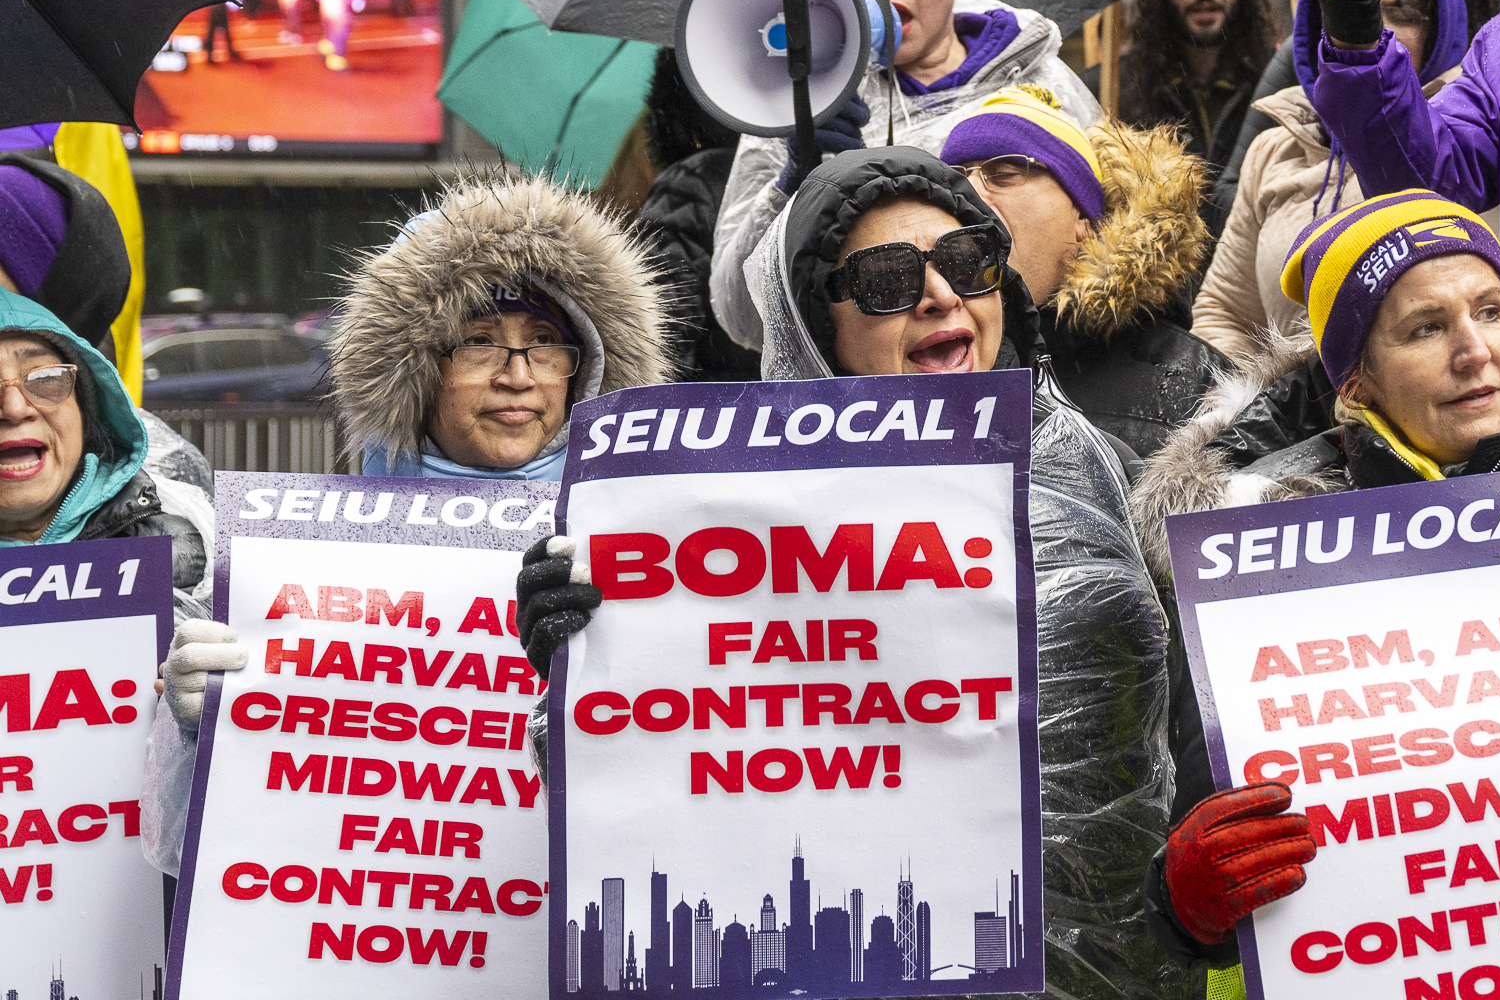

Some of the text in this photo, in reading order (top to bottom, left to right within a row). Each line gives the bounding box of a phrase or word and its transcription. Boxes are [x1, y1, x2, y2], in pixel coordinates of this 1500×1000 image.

[1356, 239, 1394, 280] LOCAL
[1363, 238, 1410, 294] SEIU
[580, 396, 998, 461] SEIU LOCAL 1
[238, 488, 558, 533] SEIU LOCA
[589, 521, 994, 600] BOMA:
[1197, 513, 1357, 580] SEIU
[0, 558, 141, 606] CAL 1
[264, 583, 441, 639] ABM,
[264, 638, 549, 697] HARVAR
[707, 618, 880, 667] FAIR
[1249, 628, 1436, 683] ABM,
[229, 691, 529, 751] CRESCE
[573, 676, 1013, 736] CONTRACT
[265, 751, 541, 809] MIDWAY
[690, 744, 903, 796] NOW!
[338, 814, 485, 860] FAIR
[221, 862, 549, 917] CONTRAC
[307, 922, 490, 970] NOW!
